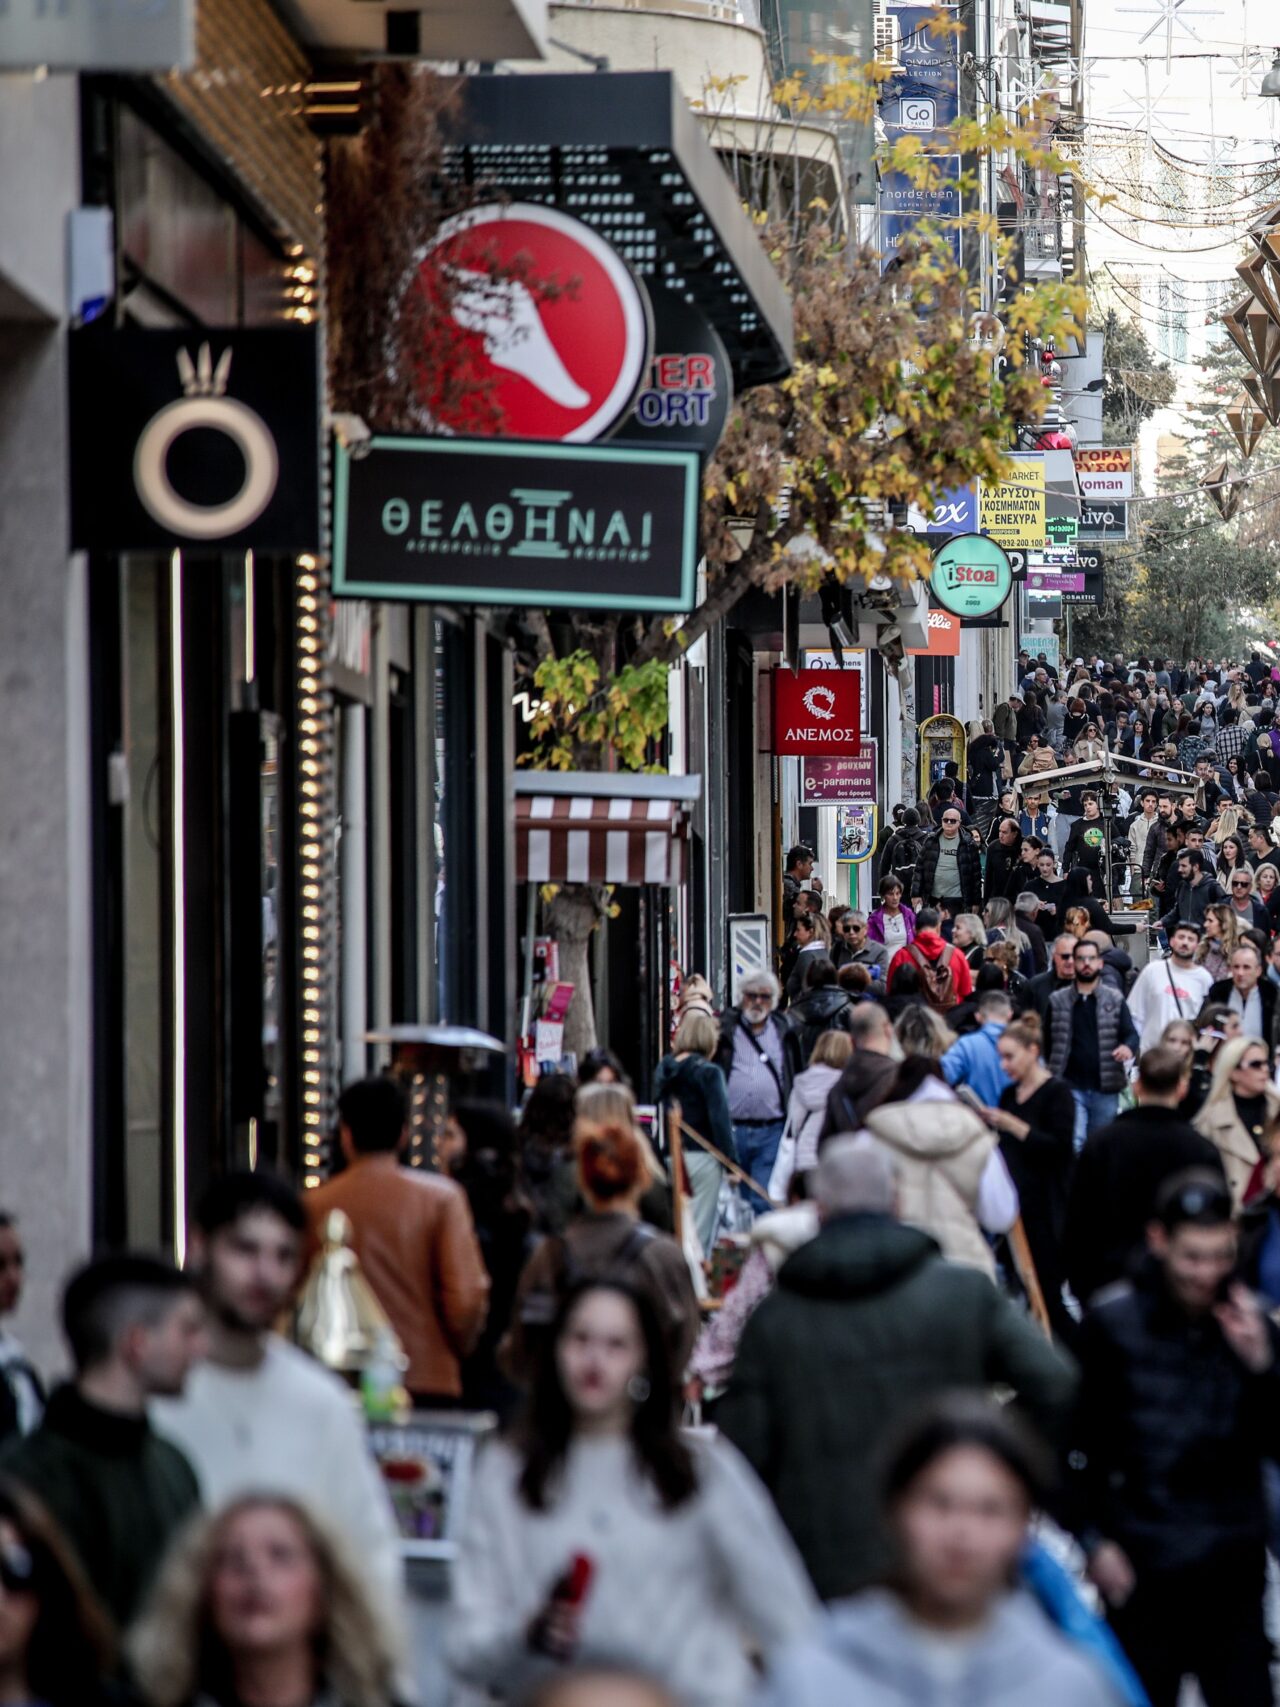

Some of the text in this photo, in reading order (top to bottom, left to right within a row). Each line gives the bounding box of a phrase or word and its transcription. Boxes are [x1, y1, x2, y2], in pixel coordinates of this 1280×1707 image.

[906, 104, 930, 121] Go
[886, 189, 954, 200] nordgreen
[1076, 462, 1130, 473] ΡΥΣΟΥ
[993, 487, 1036, 499] ΧΡΥΣΟΥ
[984, 500, 1040, 511] ΚΟΣΜΗΜΑΤΩΝ
[994, 513, 1037, 525] ΕΝΕΧΥΡΑ
[1016, 538, 1029, 547] 200
[1031, 538, 1043, 547] 100
[784, 727, 855, 742] ΑΝΕΜΟΣ
